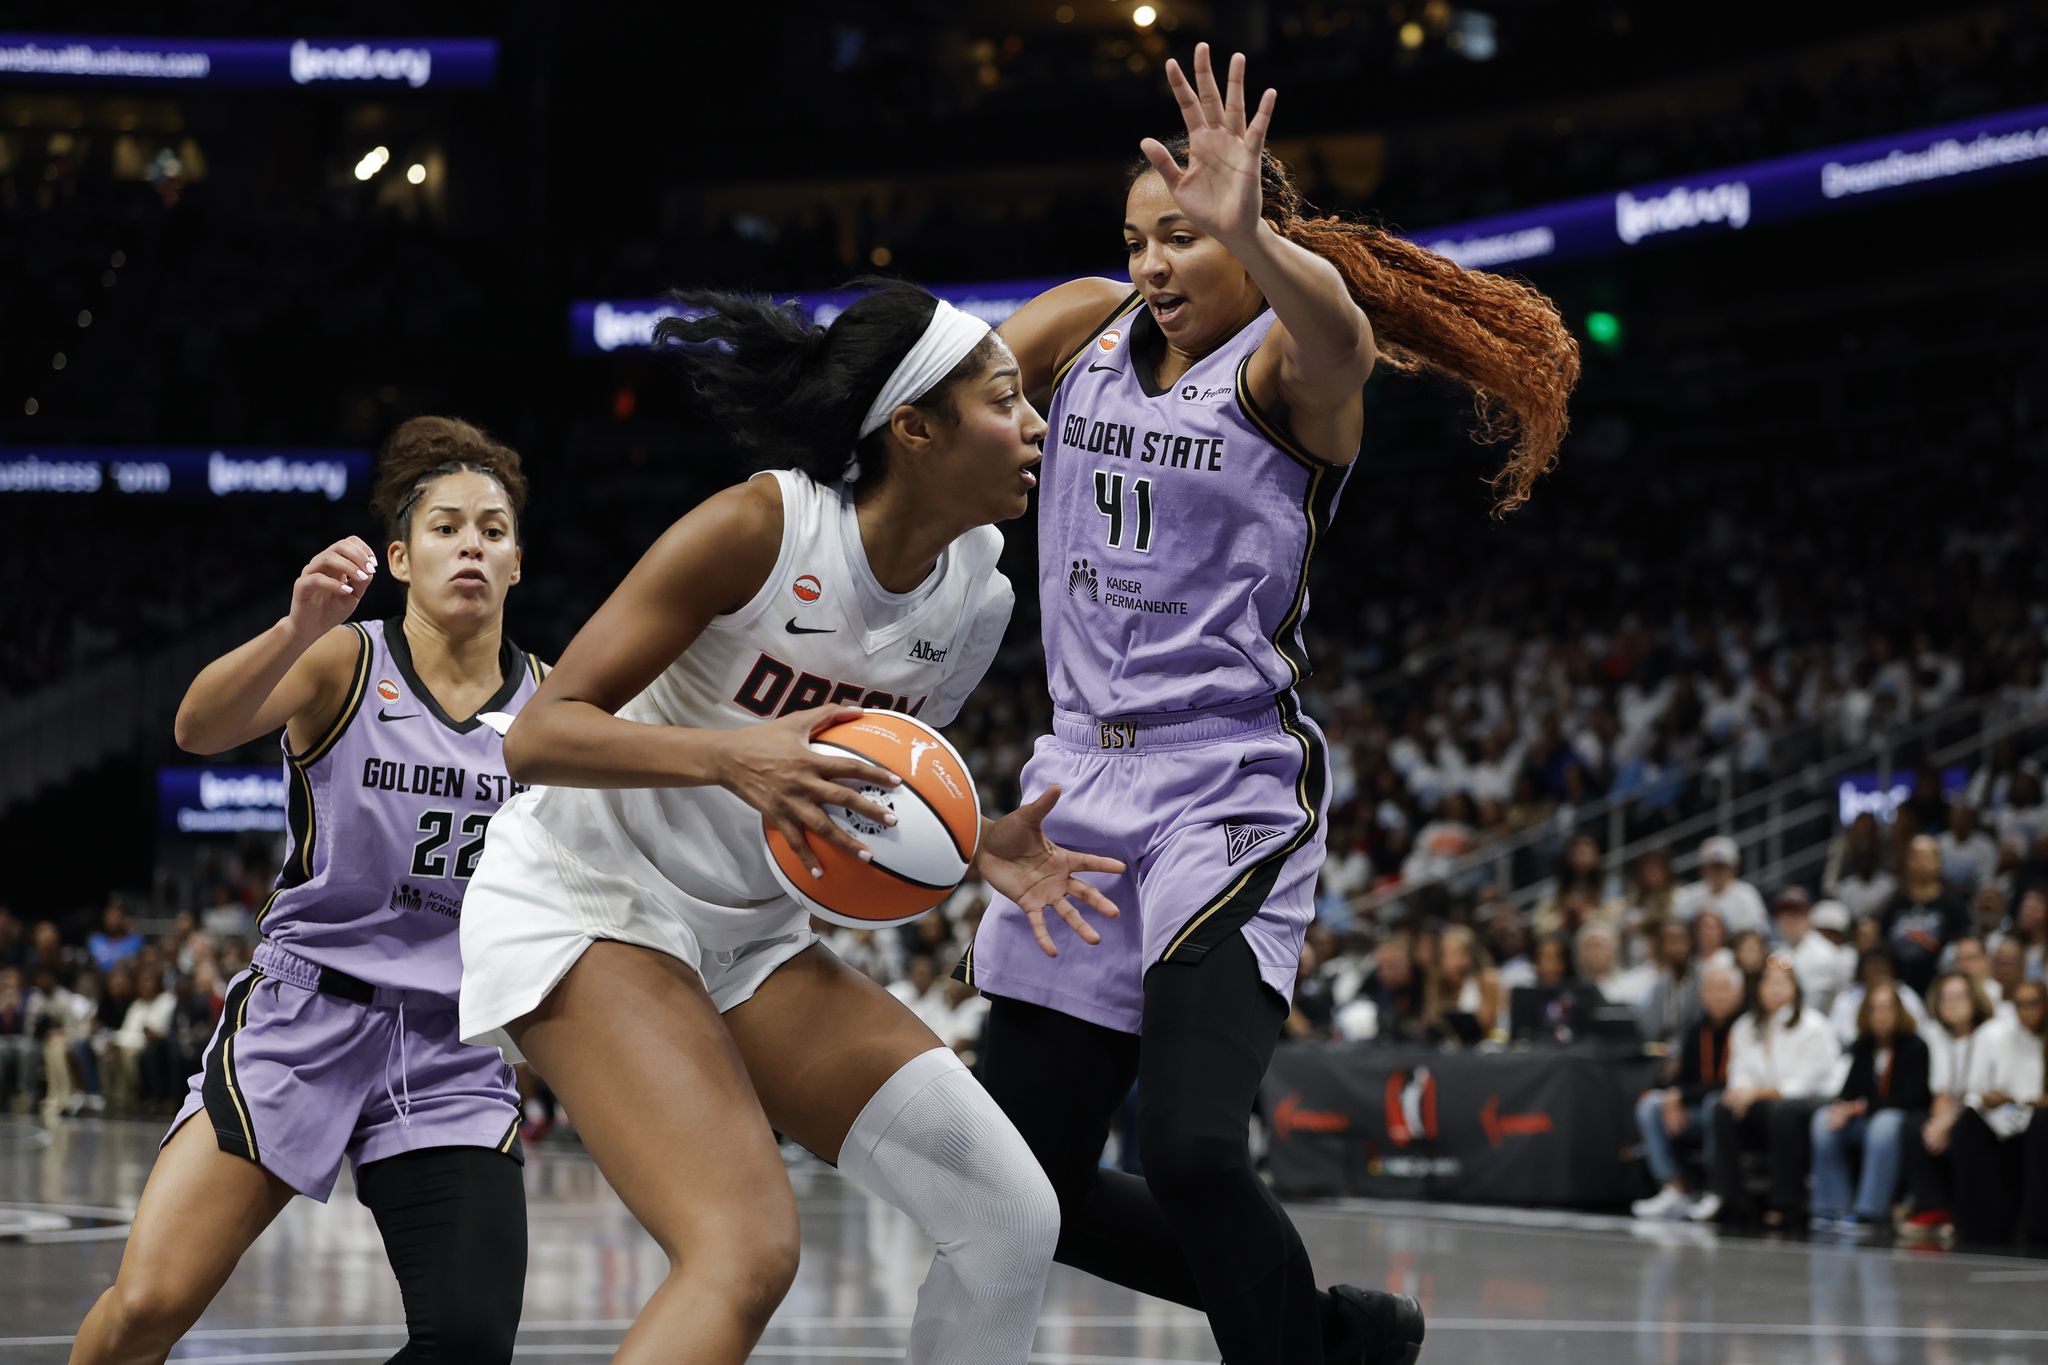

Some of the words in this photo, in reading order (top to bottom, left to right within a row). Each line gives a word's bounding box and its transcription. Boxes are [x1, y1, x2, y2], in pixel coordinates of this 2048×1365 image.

[1062, 413, 1135, 459] GOLDEN
[1140, 431, 1224, 472] STATE
[1093, 469, 1152, 553] 41
[1106, 576, 1142, 594] KAISER
[1104, 593, 1188, 615] PERMANENTE
[908, 639, 948, 663] Albert
[1100, 721, 1138, 749] GSV
[362, 757, 466, 799] GOLDEN
[409, 808, 493, 880] 22
[428, 890, 463, 908] KAISE
